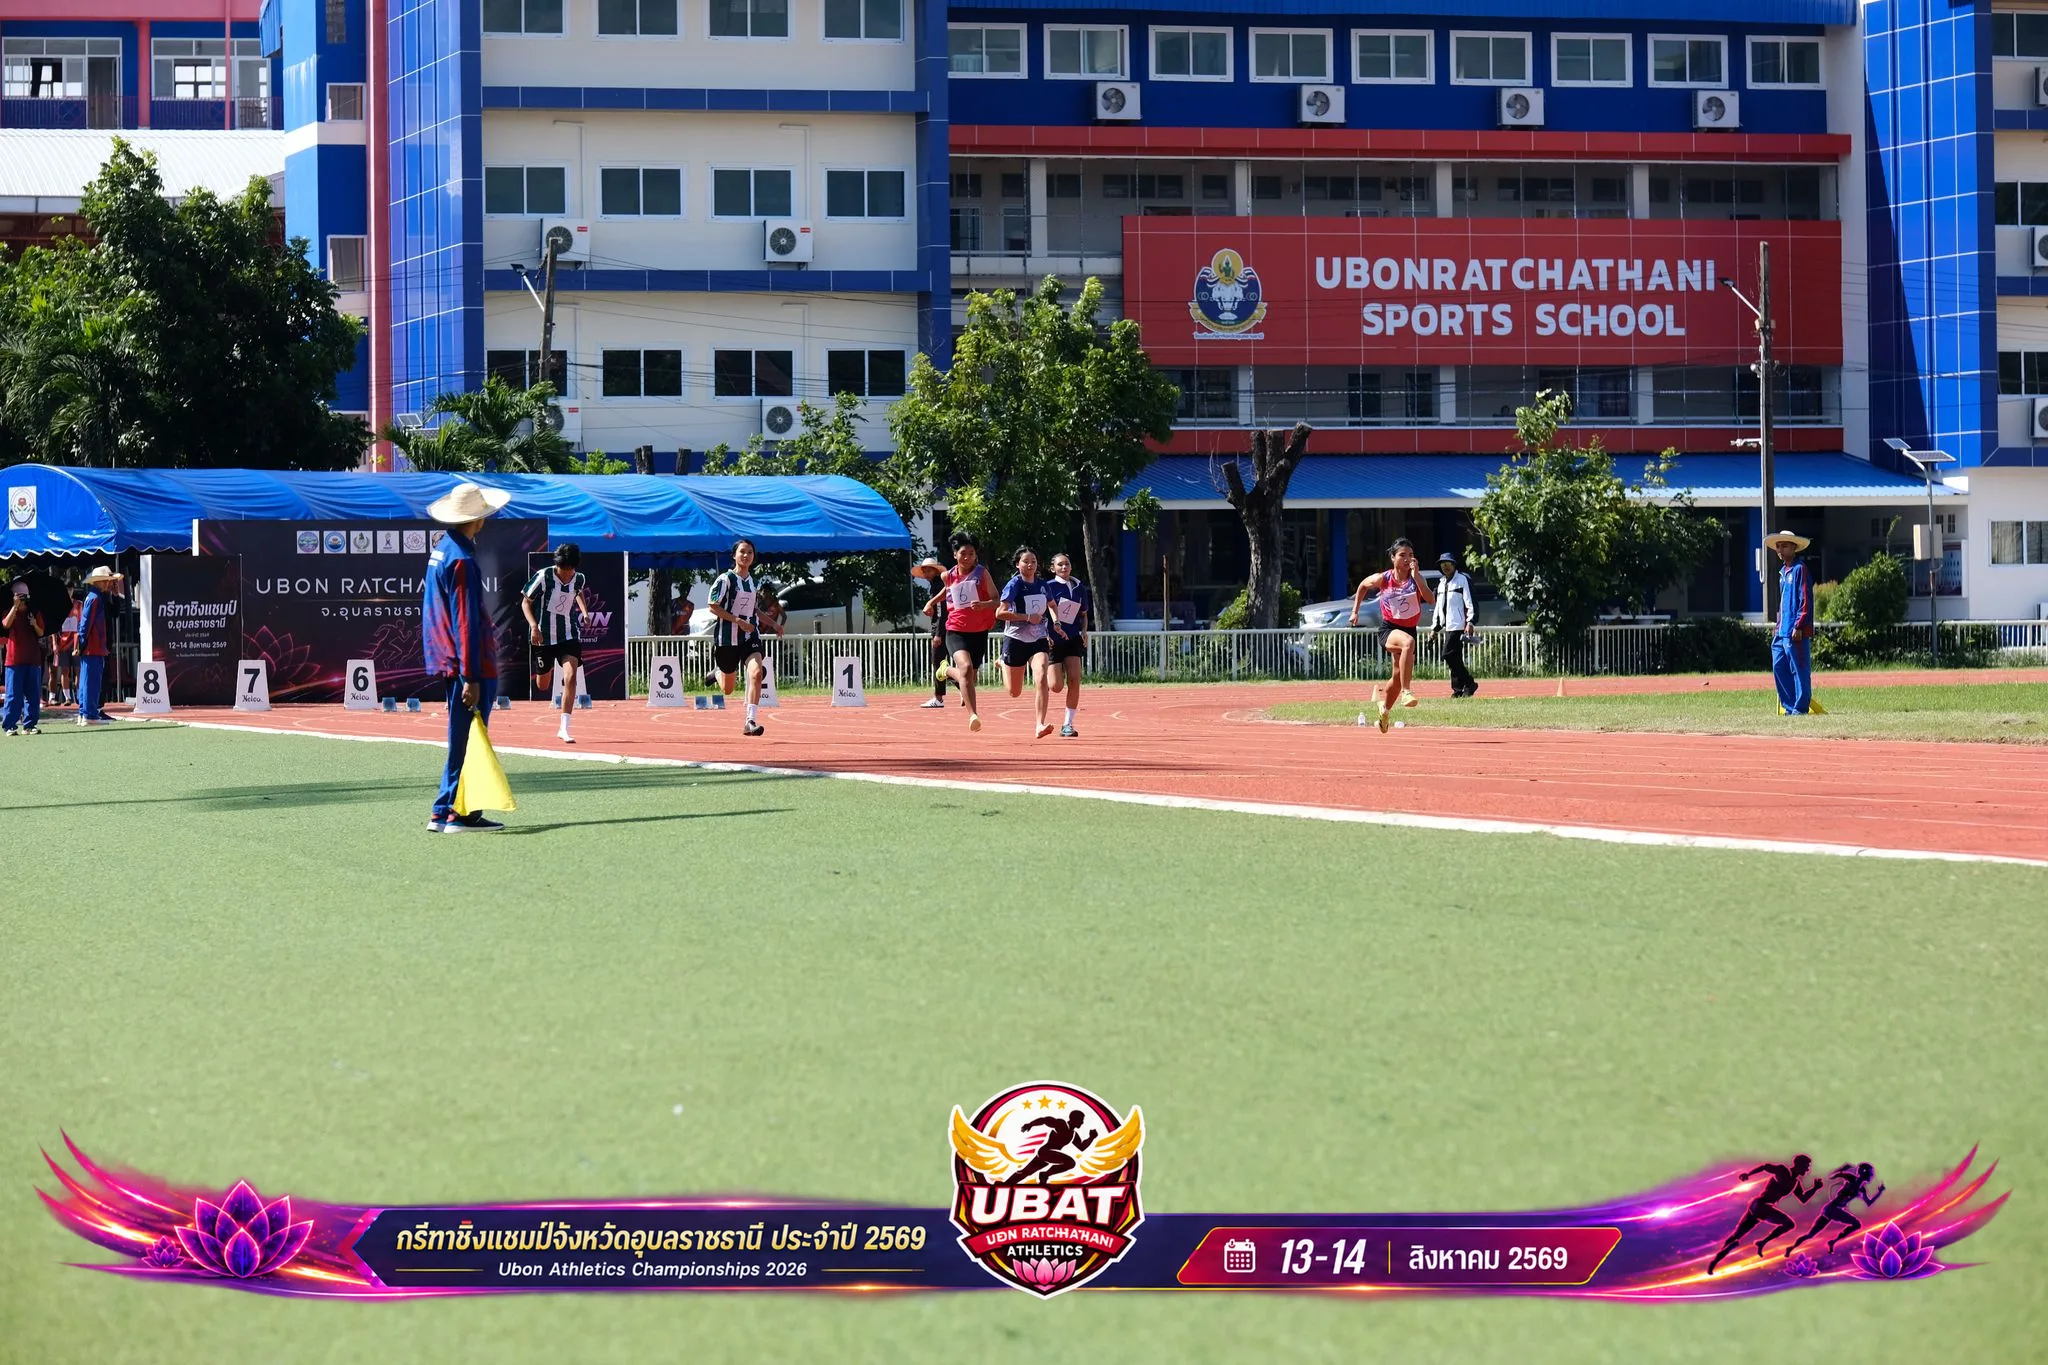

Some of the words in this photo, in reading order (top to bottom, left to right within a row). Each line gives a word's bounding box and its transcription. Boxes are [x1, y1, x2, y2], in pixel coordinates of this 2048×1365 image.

[1315, 256, 1715, 291] UBONRATCHATHANI
[1362, 302, 1513, 337] SPORTS
[1535, 302, 1686, 337] SCHOOL
[256, 577, 329, 595] UBON
[958, 586, 969, 602] 6
[555, 594, 568, 612] 8
[740, 597, 750, 610] 7
[1031, 599, 1041, 614] 5
[1062, 604, 1072, 617] 4
[1398, 598, 1410, 613] 3
[212, 641, 228, 649] 2569
[537, 657, 545, 668] 5
[143, 669, 160, 694] 8
[244, 668, 261, 693] 7
[352, 666, 370, 691] 6
[658, 664, 674, 689] 3
[842, 664, 854, 689] 1
